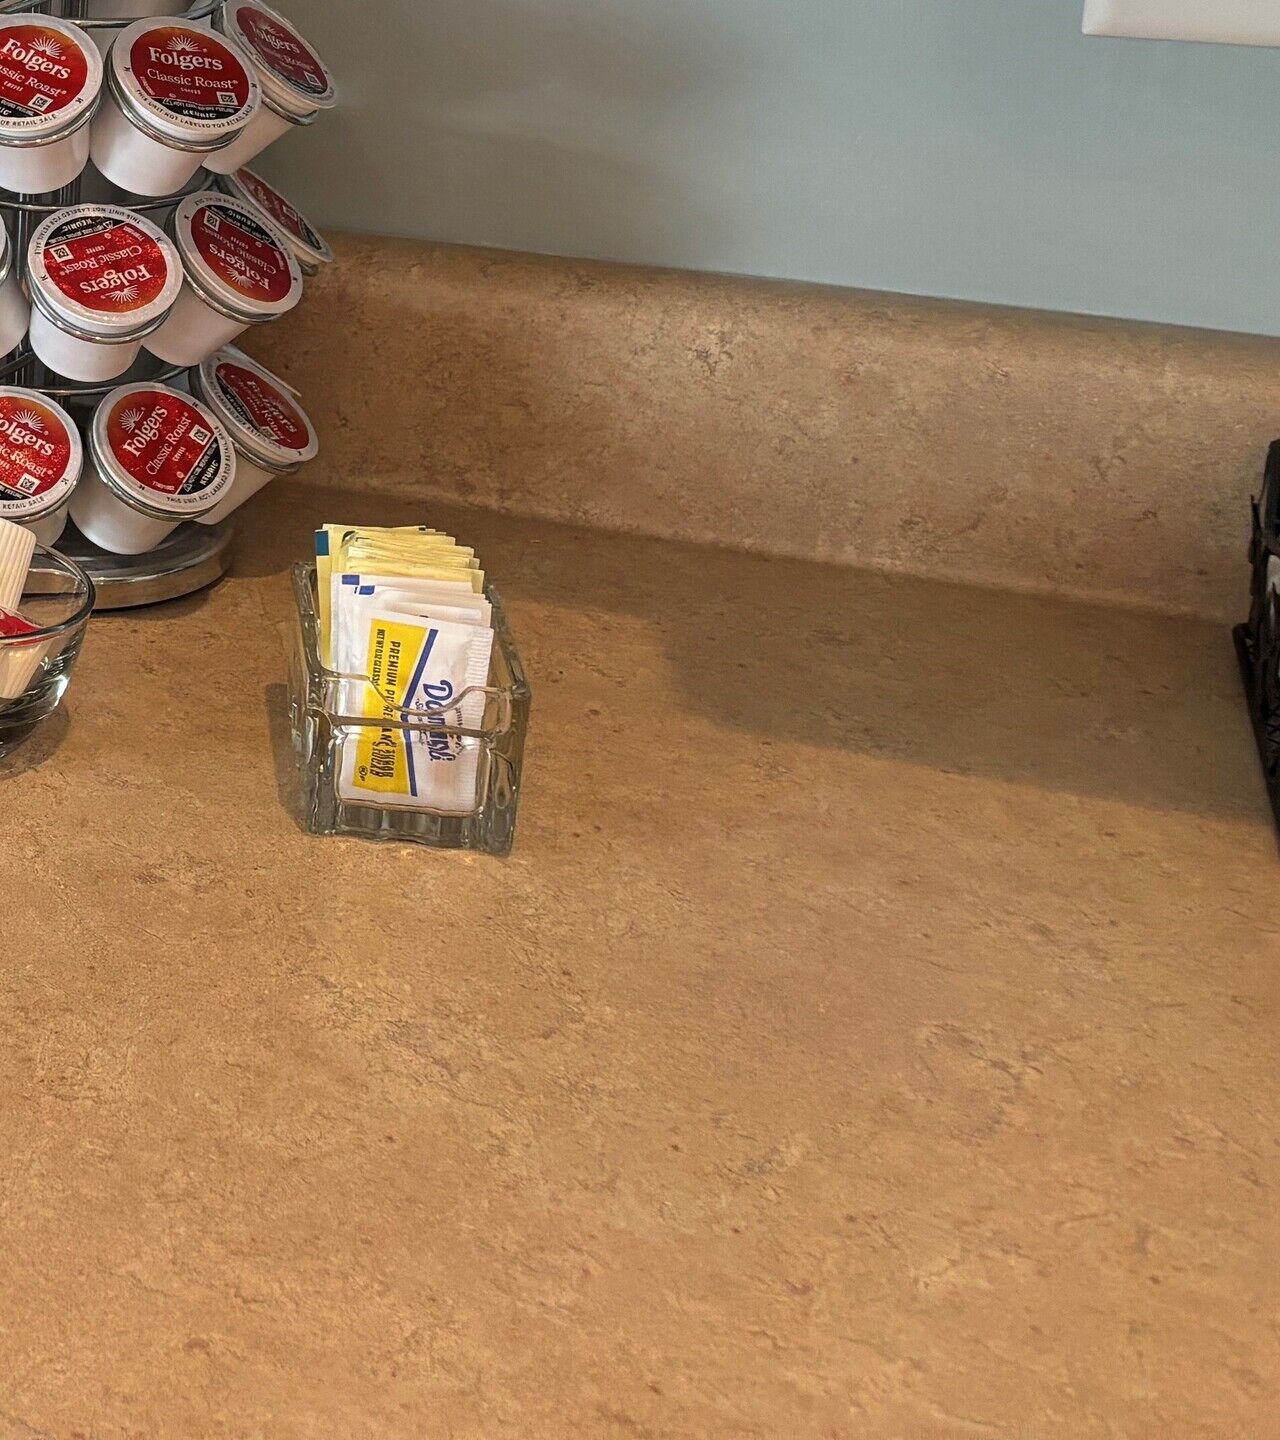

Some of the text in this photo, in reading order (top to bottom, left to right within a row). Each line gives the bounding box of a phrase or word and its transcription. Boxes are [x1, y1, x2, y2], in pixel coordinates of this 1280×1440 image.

[1, 38, 71, 79] Folgers
[148, 46, 223, 70] Folgers
[25, 76, 61, 97] Roast
[146, 68, 192, 86] Classic
[194, 76, 234, 89] Roast
[65, 245, 142, 274] Classic Roast
[209, 243, 271, 290] Folgers
[80, 264, 153, 294] Folgers
[122, 405, 168, 457] Folgers
[145, 443, 173, 475] Classic
[165, 415, 191, 444] Roast
[9, 450, 48, 478] Roast
[199, 460, 219, 486] KEURIG
[385, 640, 401, 687] PREMIUM
